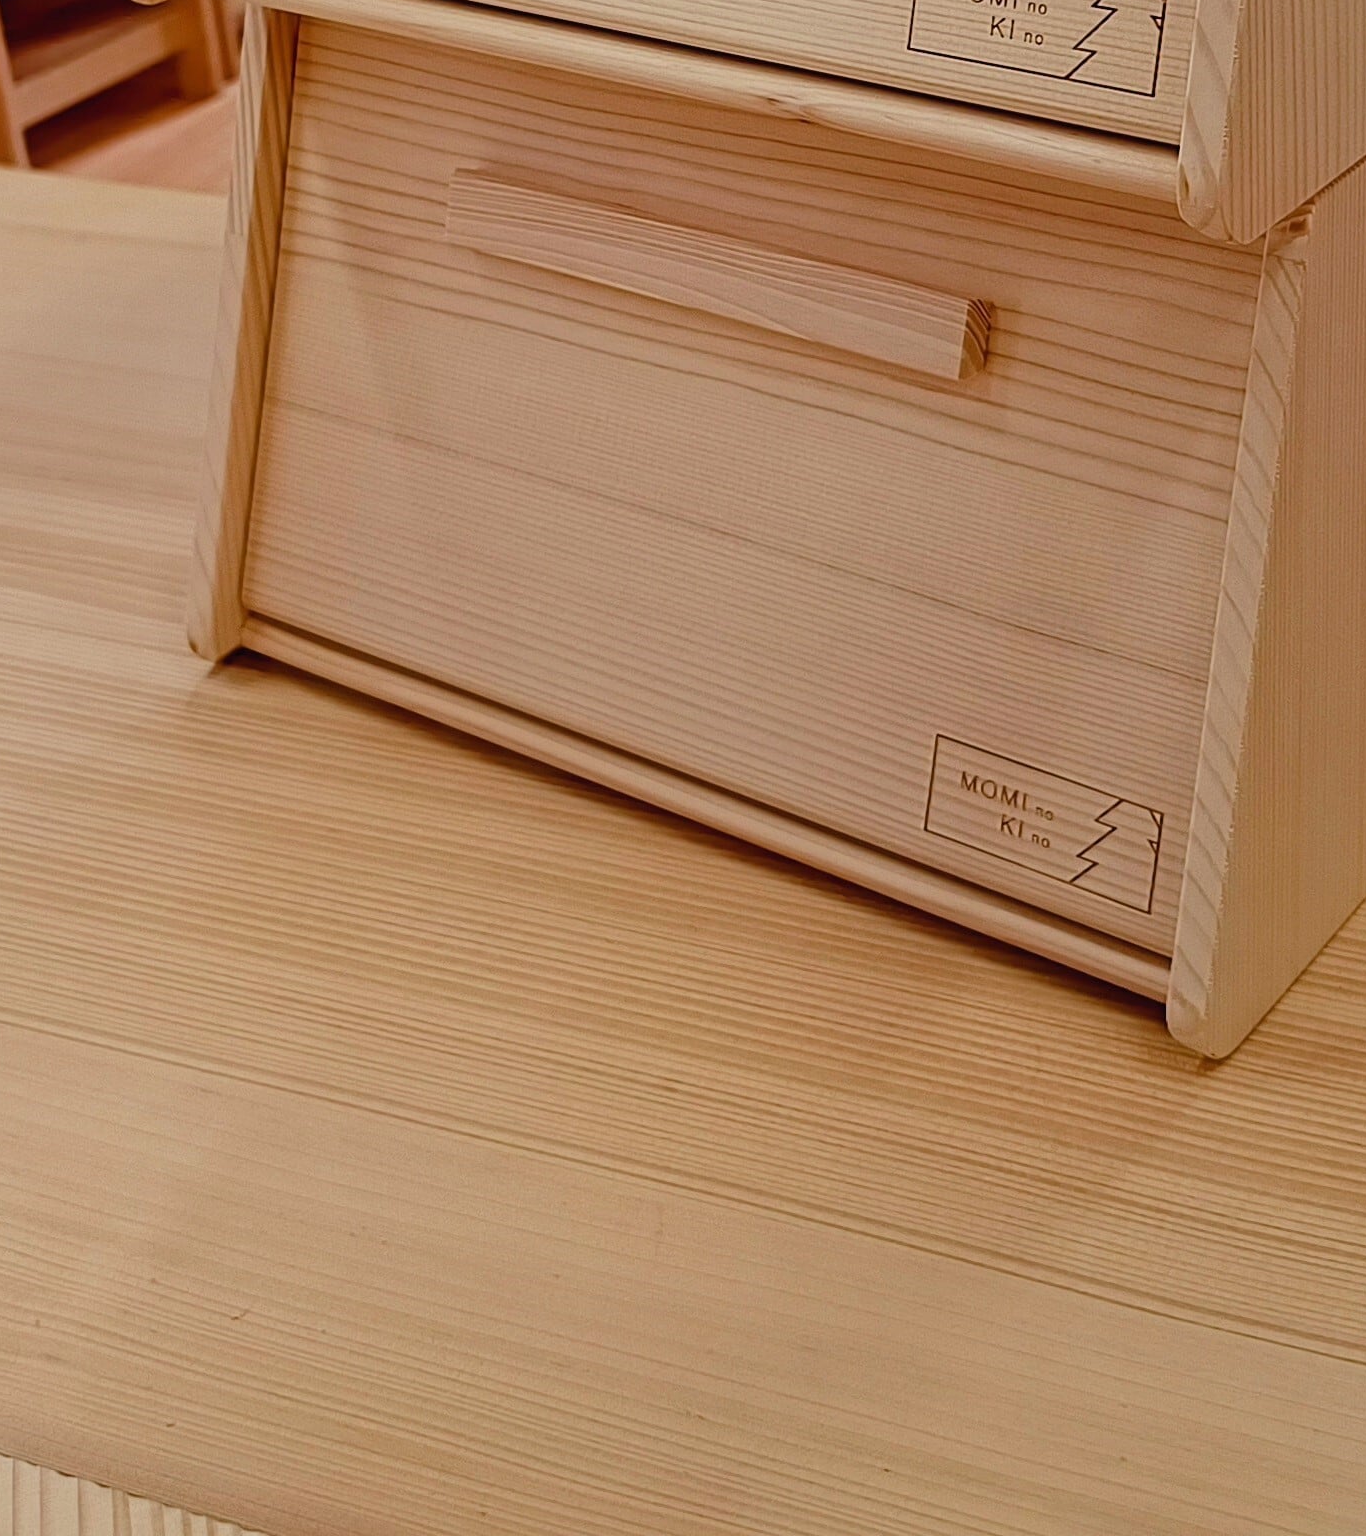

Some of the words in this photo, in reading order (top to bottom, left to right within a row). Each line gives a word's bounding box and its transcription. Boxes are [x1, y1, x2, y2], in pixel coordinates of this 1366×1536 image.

[1027, 0, 1048, 16] no
[989, 15, 1016, 40] KI
[1023, 31, 1044, 46] no
[960, 770, 1029, 812] MOMI
[1035, 804, 1055, 822] no
[1000, 814, 1025, 839] KI
[1031, 832, 1051, 849] no
